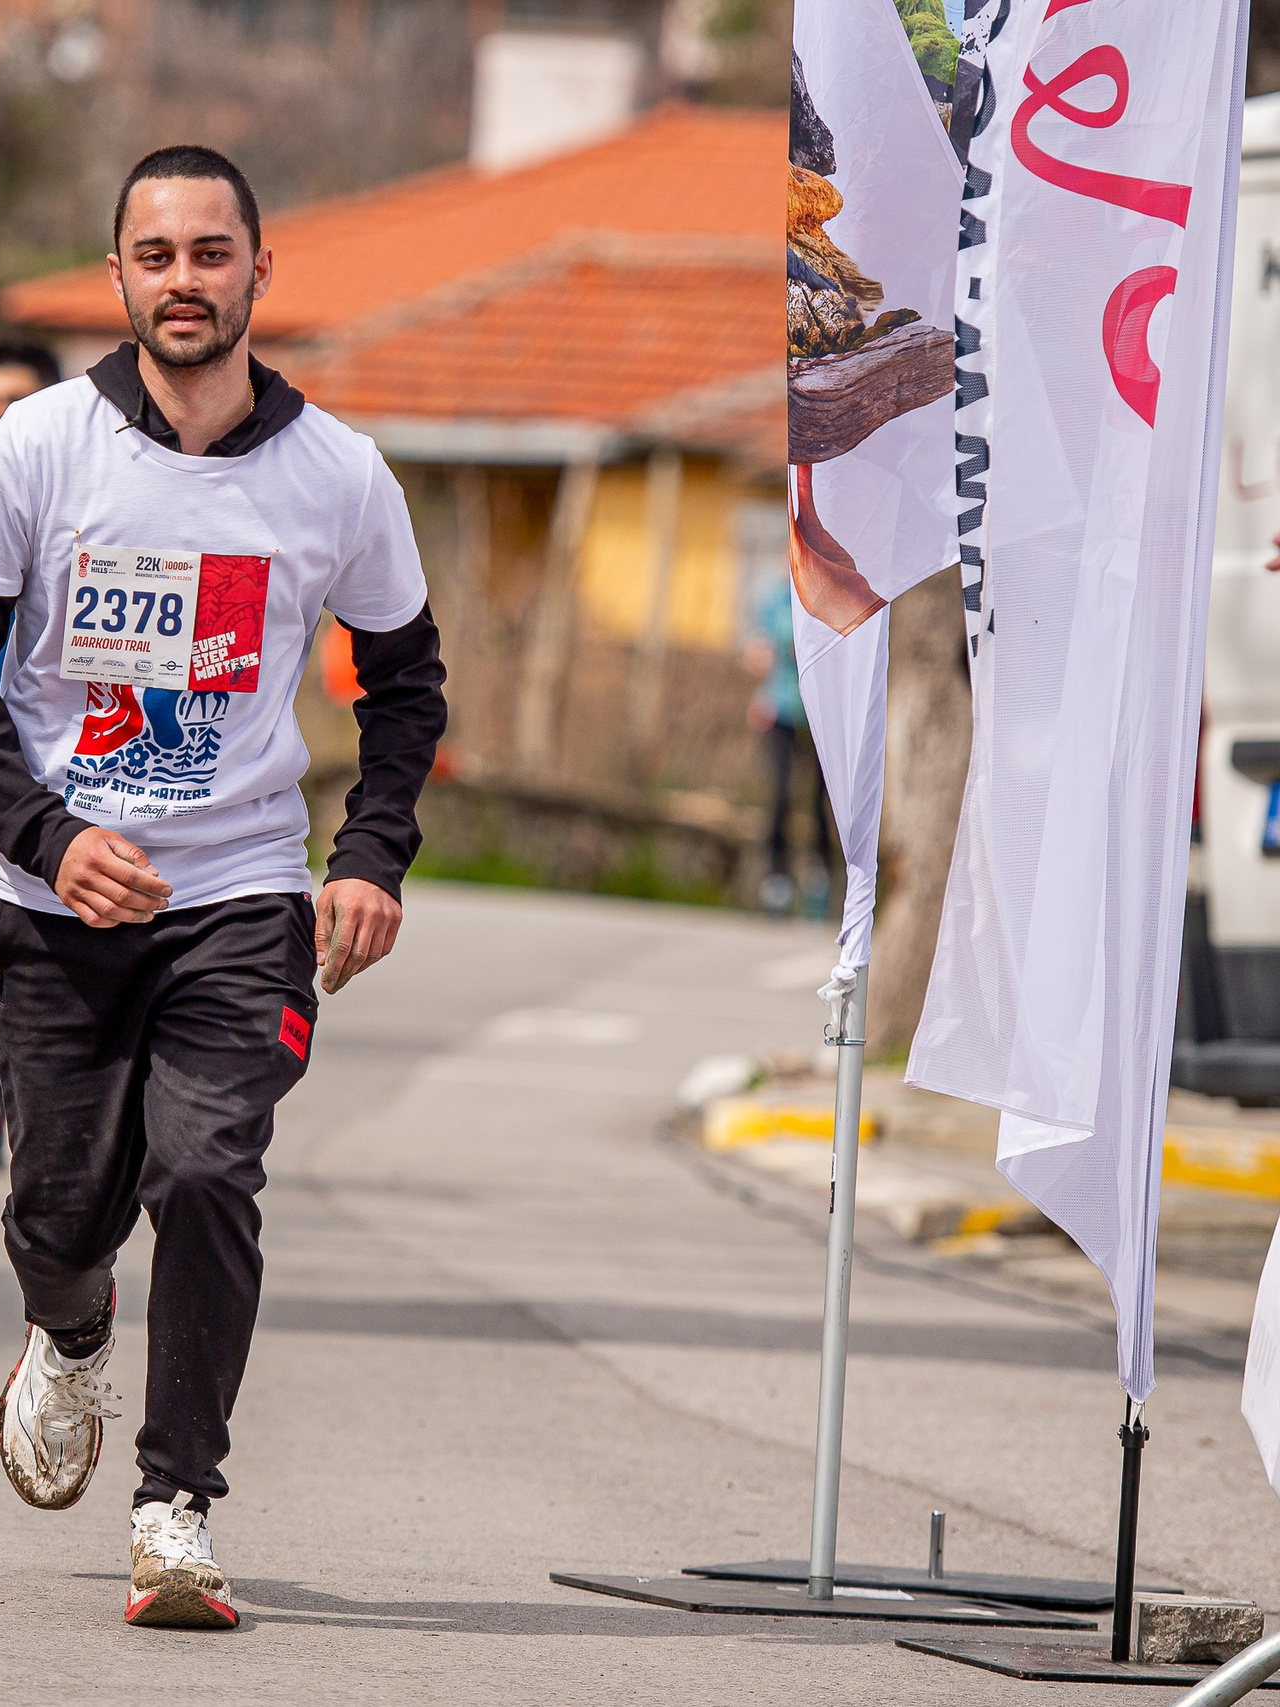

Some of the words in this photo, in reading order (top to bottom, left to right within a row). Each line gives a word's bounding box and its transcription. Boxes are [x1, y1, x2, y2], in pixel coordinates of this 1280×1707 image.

[91, 559, 118, 567] PLOVDIV
[136, 556, 161, 572] 22K
[164, 561, 193, 571] 1000D+
[72, 586, 183, 637] 2378
[70, 635, 124, 652] MARKOVO
[124, 639, 151, 652] TRAIL
[192, 631, 236, 655] EVERY
[192, 647, 229, 668] STEP
[194, 652, 260, 681] MATTERS
[66, 768, 110, 787] EVERY
[111, 779, 146, 796] STEP
[149, 788, 211, 801] MATTERS
[73, 799, 92, 811] HILLS
[76, 791, 103, 804] PLOVDIV
[285, 1020, 305, 1046] HUGO
